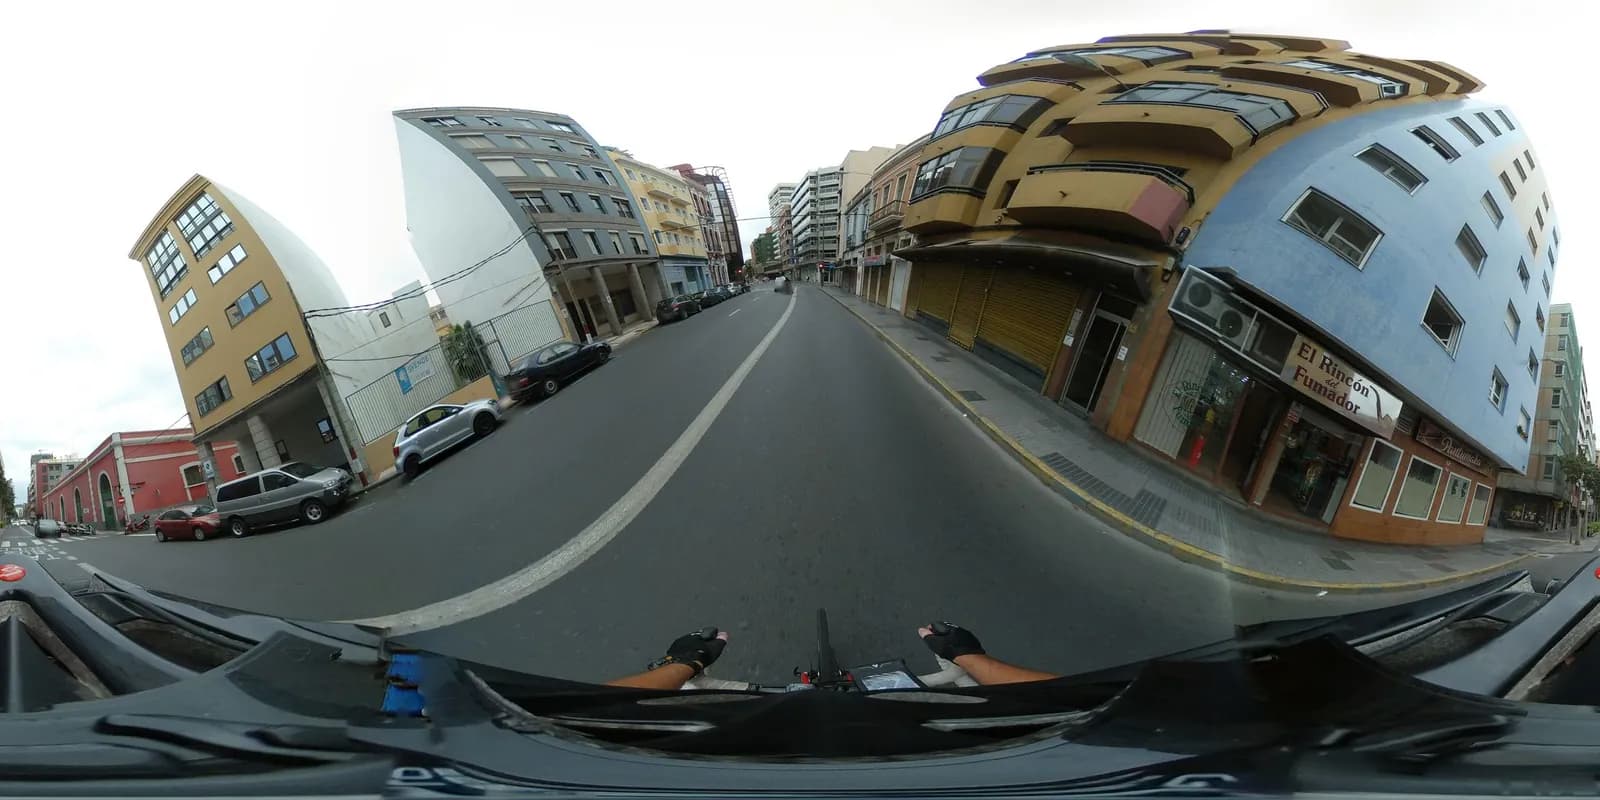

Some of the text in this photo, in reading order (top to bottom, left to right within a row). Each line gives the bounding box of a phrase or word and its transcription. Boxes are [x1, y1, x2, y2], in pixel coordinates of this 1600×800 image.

[1294, 365, 1360, 414] Fumador
[1297, 342, 1370, 398] El Rincón
